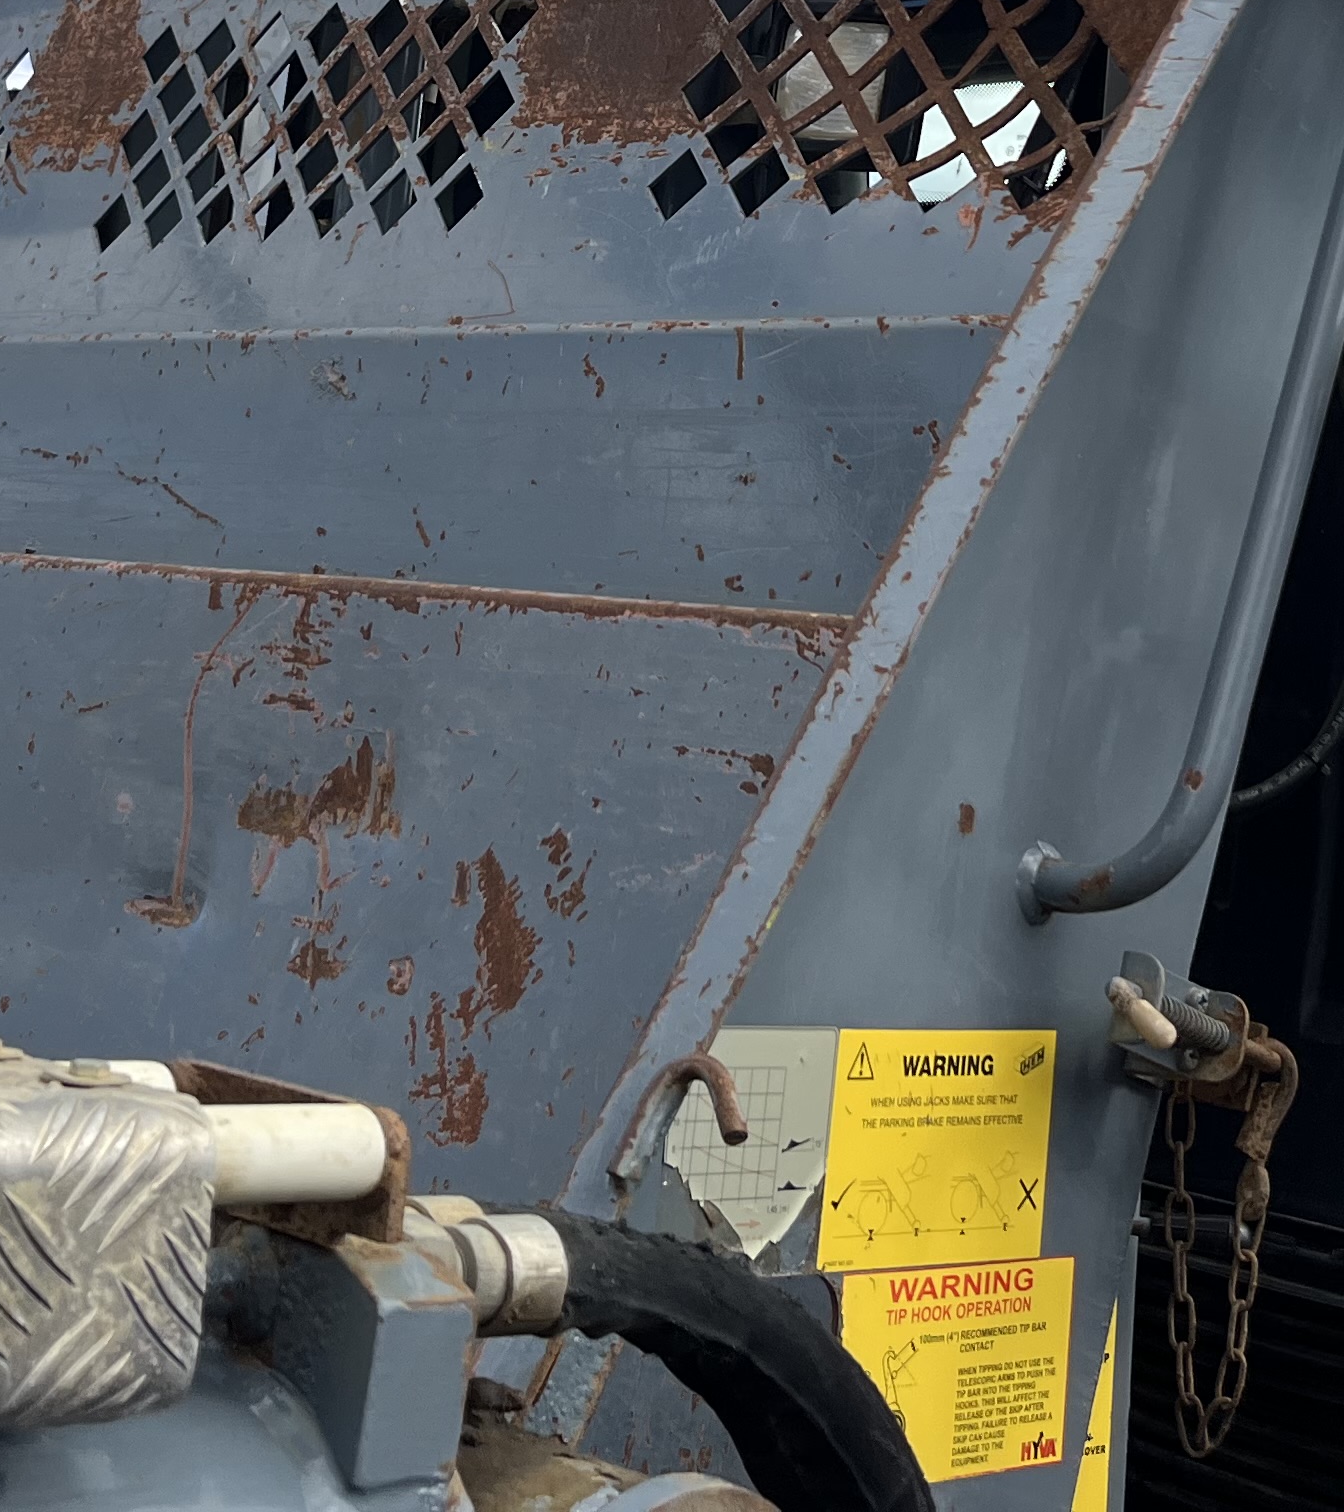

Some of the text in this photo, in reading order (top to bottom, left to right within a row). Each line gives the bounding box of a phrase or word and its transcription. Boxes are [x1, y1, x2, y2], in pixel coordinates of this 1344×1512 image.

[903, 1054, 995, 1078] WARNING
[870, 1094, 1018, 1108] WHEN USING JACKS MAKE SURE THAT
[862, 1113, 1023, 1129] THE PARKING BRAKE REMAINS EFFECTIVE
[890, 1268, 1033, 1303] WARNING
[886, 1296, 1032, 1326] TIP HOOK OPERATION
[919, 1334, 945, 1344] 100mm
[960, 1325, 1018, 1340] RECOMMENDED
[1019, 1323, 1030, 1333] TIP
[1031, 1321, 1047, 1332] BAR
[959, 1340, 995, 1353] CONTACT
[958, 1356, 1055, 1376] WHEN TIPPING DO NOT USE THE
[957, 1367, 1056, 1387] TELESCOPIC ARMS TO PUSH THE
[956, 1381, 1036, 1399] TIP BAR INTO THE TIPPING
[981, 1397, 996, 1406] THIS
[997, 1395, 1011, 1404] WILL
[1012, 1392, 1036, 1402] AFFECT
[1037, 1390, 1050, 1399] THE
[954, 1402, 1045, 1422] RELEASE OF THE SKIP AFTER
[981, 1418, 1008, 1429] FAILURE
[1009, 1416, 1018, 1425] TO
[1019, 1412, 1047, 1424] RELEASE
[1048, 1411, 1053, 1420] A
[953, 1429, 1005, 1445] SKIP CAN CAUSE
[1020, 1431, 1057, 1462] HYVA
[952, 1440, 1004, 1457] DAMAGE TO THE
